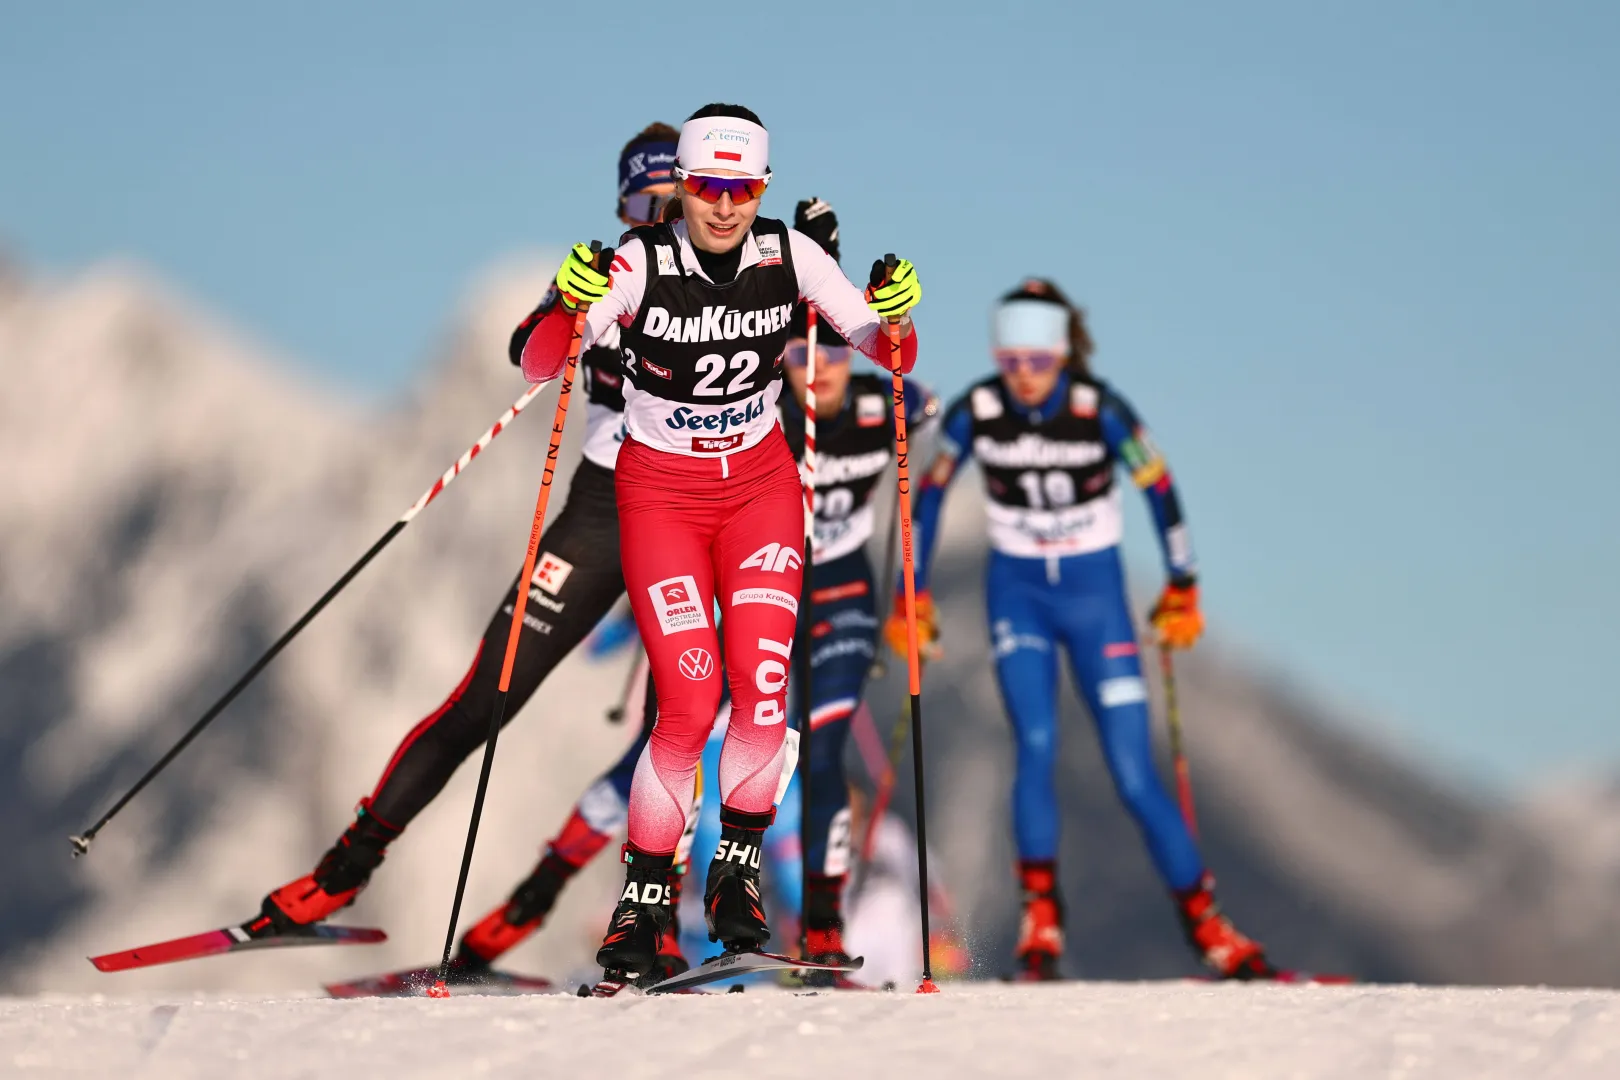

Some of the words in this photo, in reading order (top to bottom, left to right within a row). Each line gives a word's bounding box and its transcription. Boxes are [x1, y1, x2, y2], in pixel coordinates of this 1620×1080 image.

[719, 133, 750, 146] termy
[692, 350, 761, 397] 22
[665, 395, 764, 434] Seefeld
[903, 518, 910, 528] 40
[527, 523, 540, 556] PREMIO
[904, 531, 912, 563] PREMIO
[665, 612, 702, 624] UPSTREAM
[666, 605, 697, 617] ORLEN
[670, 618, 701, 628] NORWAY
[753, 636, 793, 726] POL
